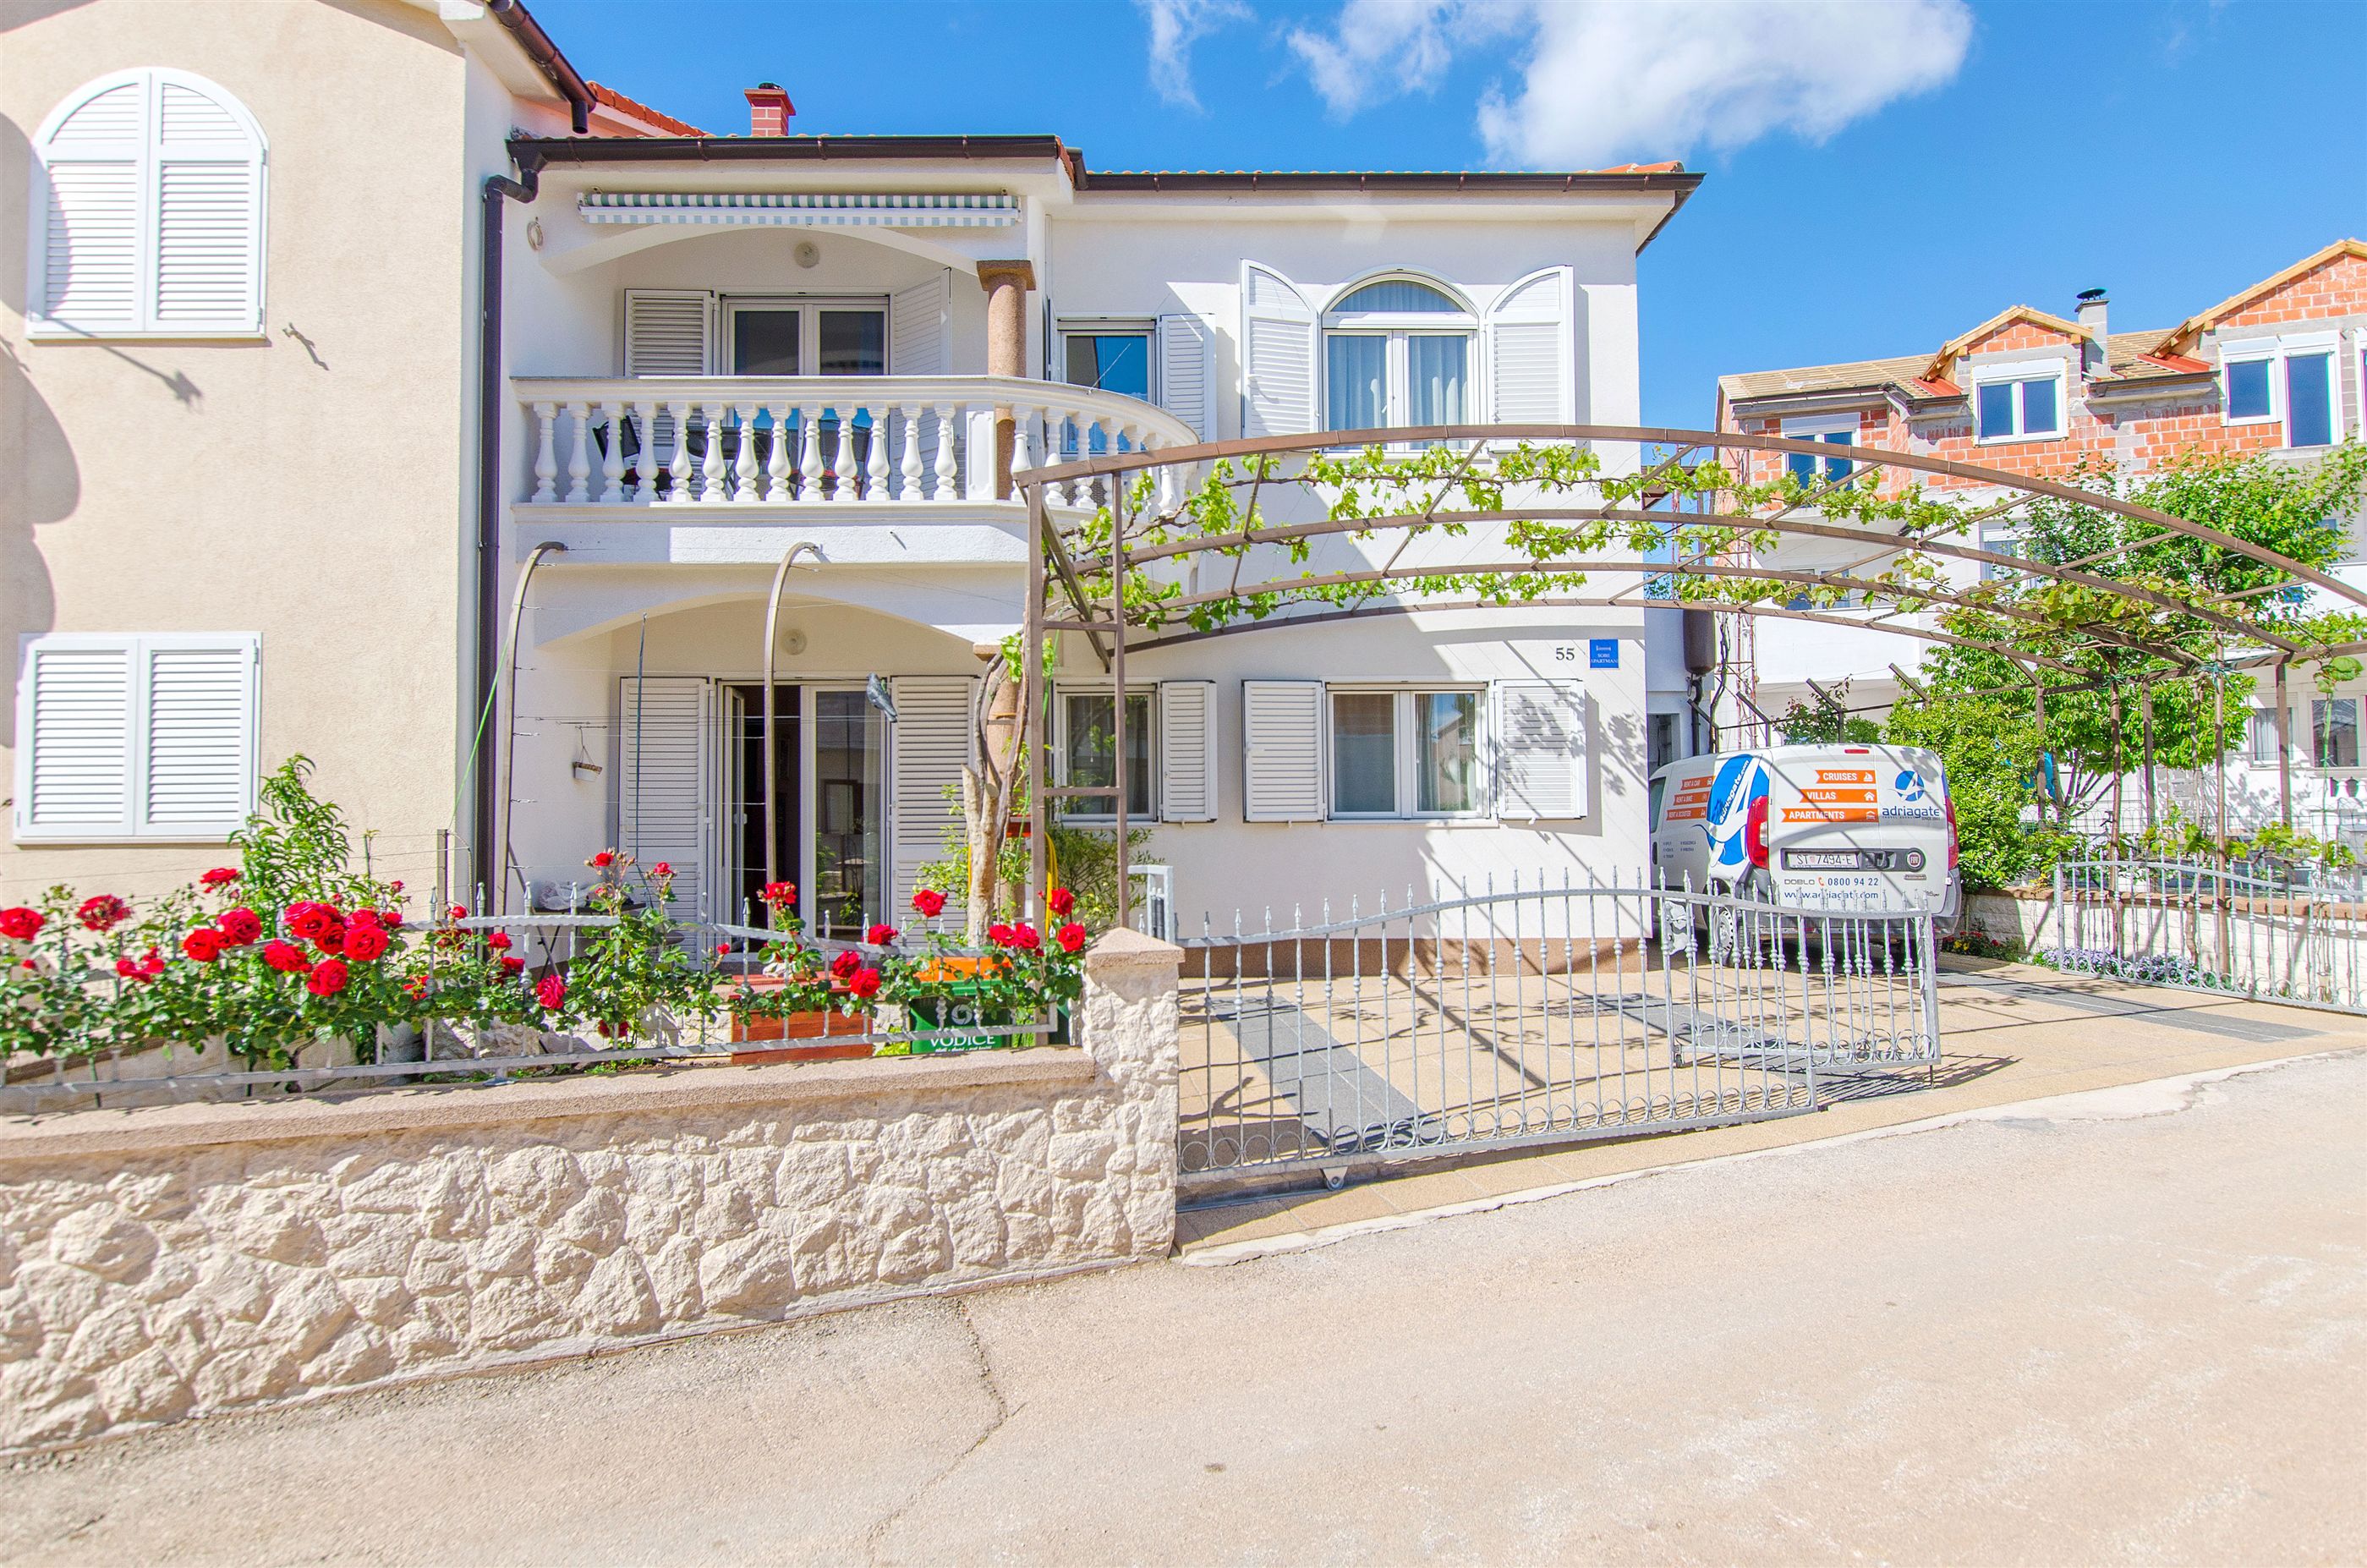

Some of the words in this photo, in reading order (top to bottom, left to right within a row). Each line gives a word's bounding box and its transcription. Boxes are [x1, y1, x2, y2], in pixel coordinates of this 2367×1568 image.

[1555, 647, 1575, 661] 55
[1822, 772, 1858, 781] CRUISES
[1719, 760, 1750, 824] adriagate.com
[1806, 792, 1837, 800] VILLAS
[1789, 811, 1845, 820] APARTMENTS
[1882, 806, 1940, 818] adriagate
[1797, 854, 1809, 865] ST
[1816, 854, 1853, 865] 7494-E
[1827, 878, 1850, 886] 0800
[1854, 878, 1865, 886] 94
[1868, 878, 1879, 886] 22
[930, 1034, 995, 1047] VODICE
